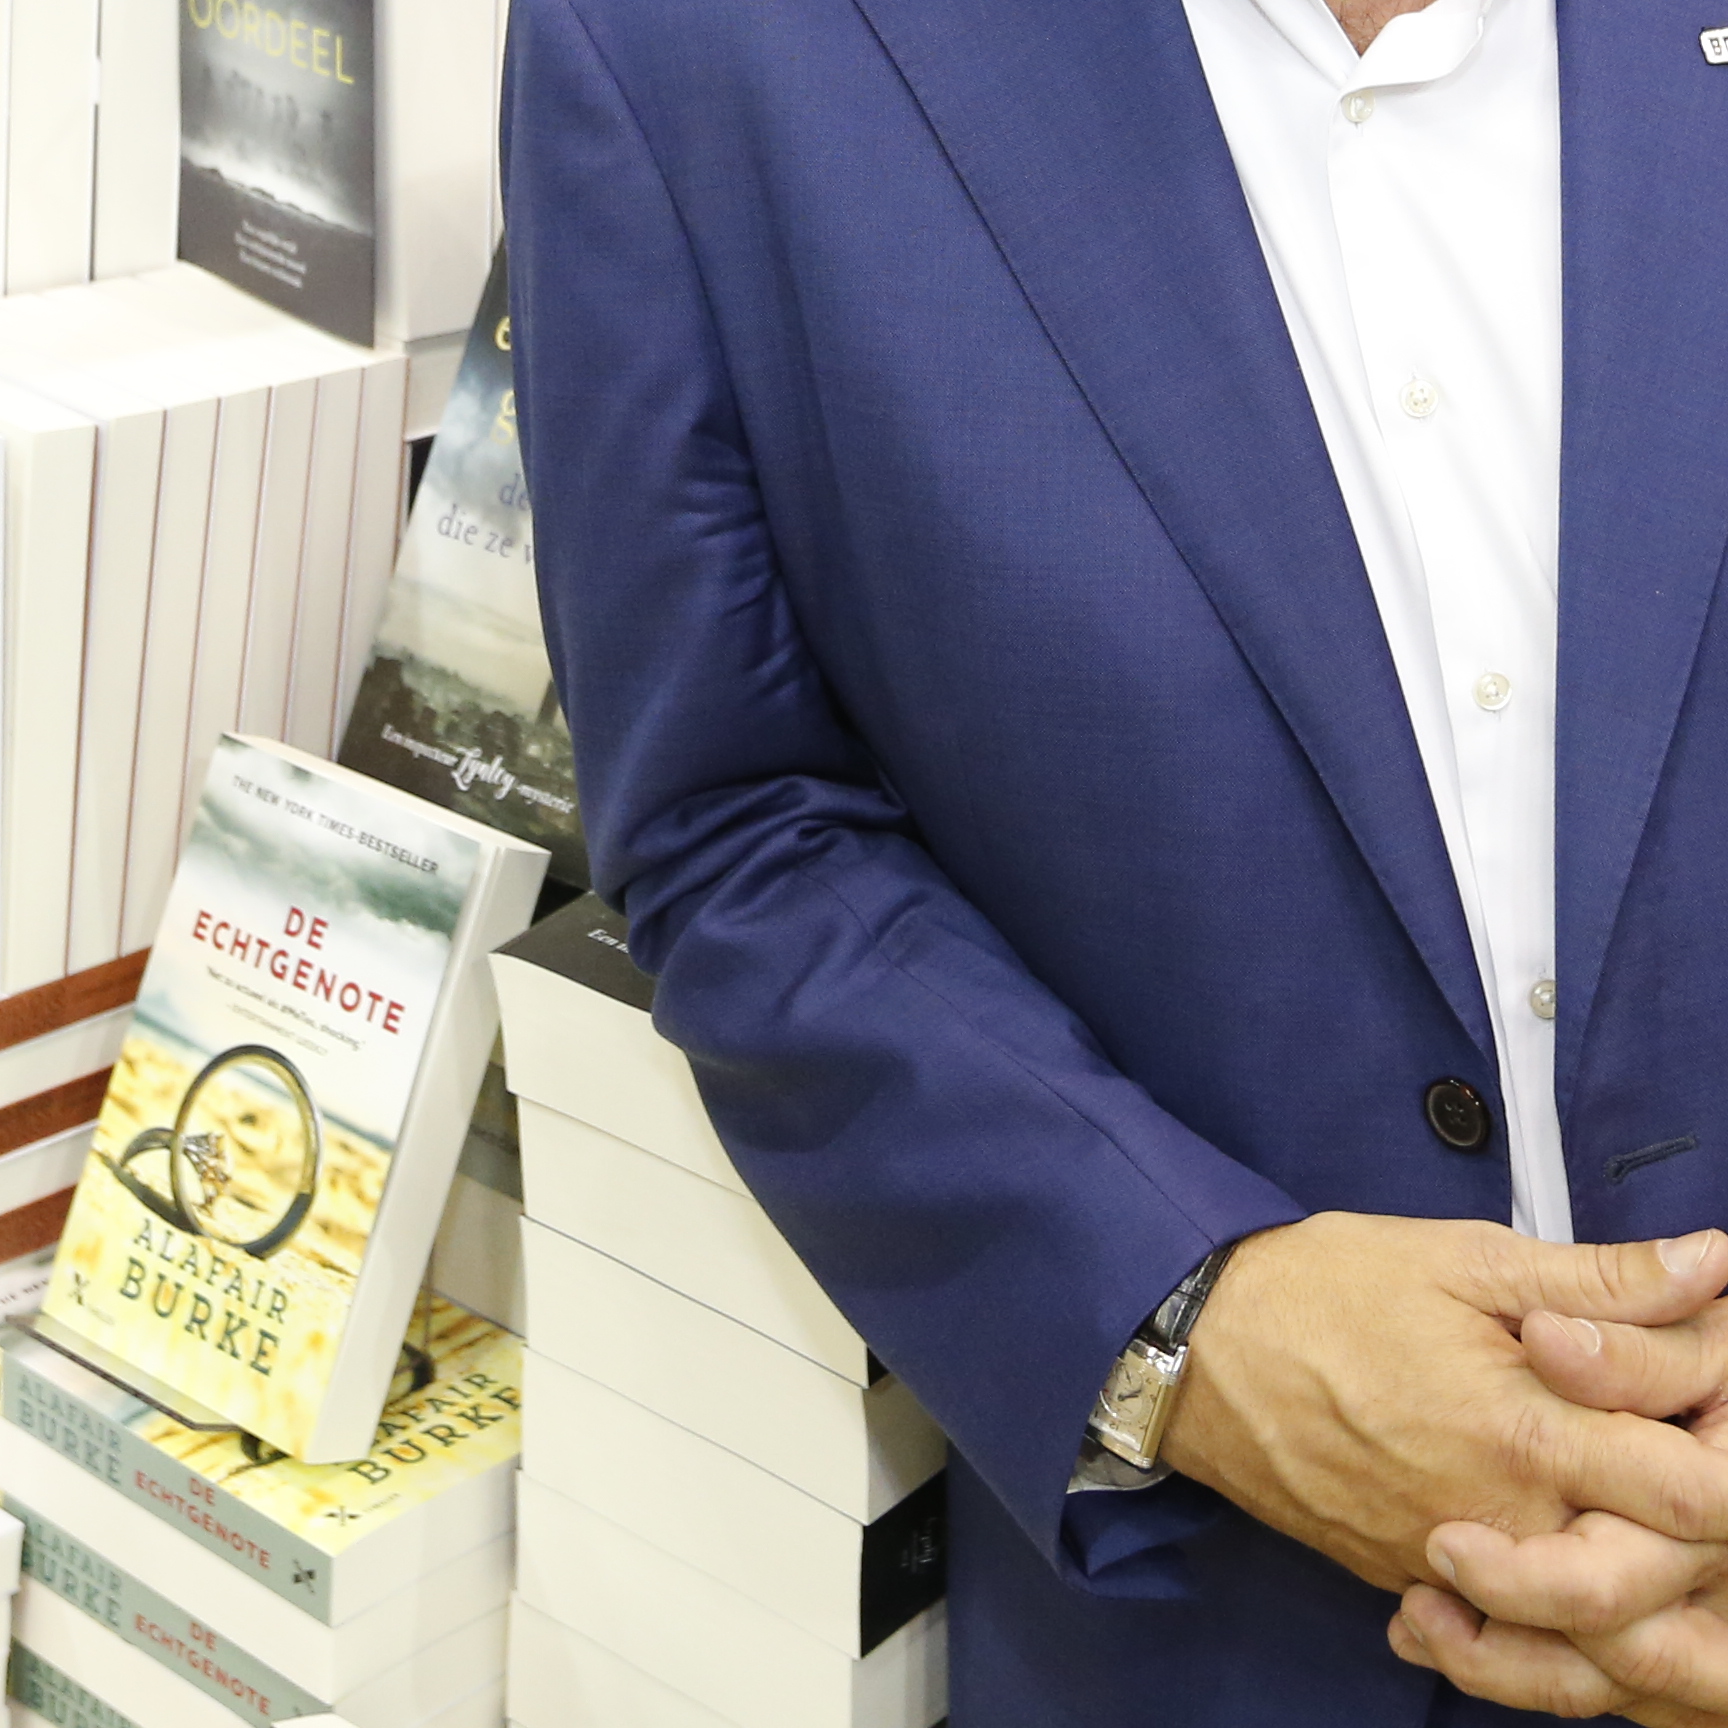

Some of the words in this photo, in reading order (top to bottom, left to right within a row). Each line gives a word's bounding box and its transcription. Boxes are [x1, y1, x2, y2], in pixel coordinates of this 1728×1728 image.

[437, 505, 477, 548] die
[485, 529, 515, 559] ze
[232, 774, 253, 794] THE
[256, 786, 280, 808] NEW
[283, 798, 314, 824] YORK
[450, 746, 516, 802] Lynley
[283, 905, 330, 951] DE
[191, 908, 406, 1036] ECHTGENOTE
[133, 1217, 289, 1326] ALAFAIR
[118, 1256, 281, 1378] BURKE
[18, 1374, 124, 1455] ALAFAIR
[18, 1402, 124, 1488] BURKE
[348, 1385, 522, 1486] BURKE
[372, 1370, 500, 1445] AFAIR
[133, 1468, 272, 1571] ECHTGENOTE
[188, 1475, 218, 1507] DE
[133, 1612, 272, 1718] ECHTGENOTE
[188, 1620, 219, 1653] DE
